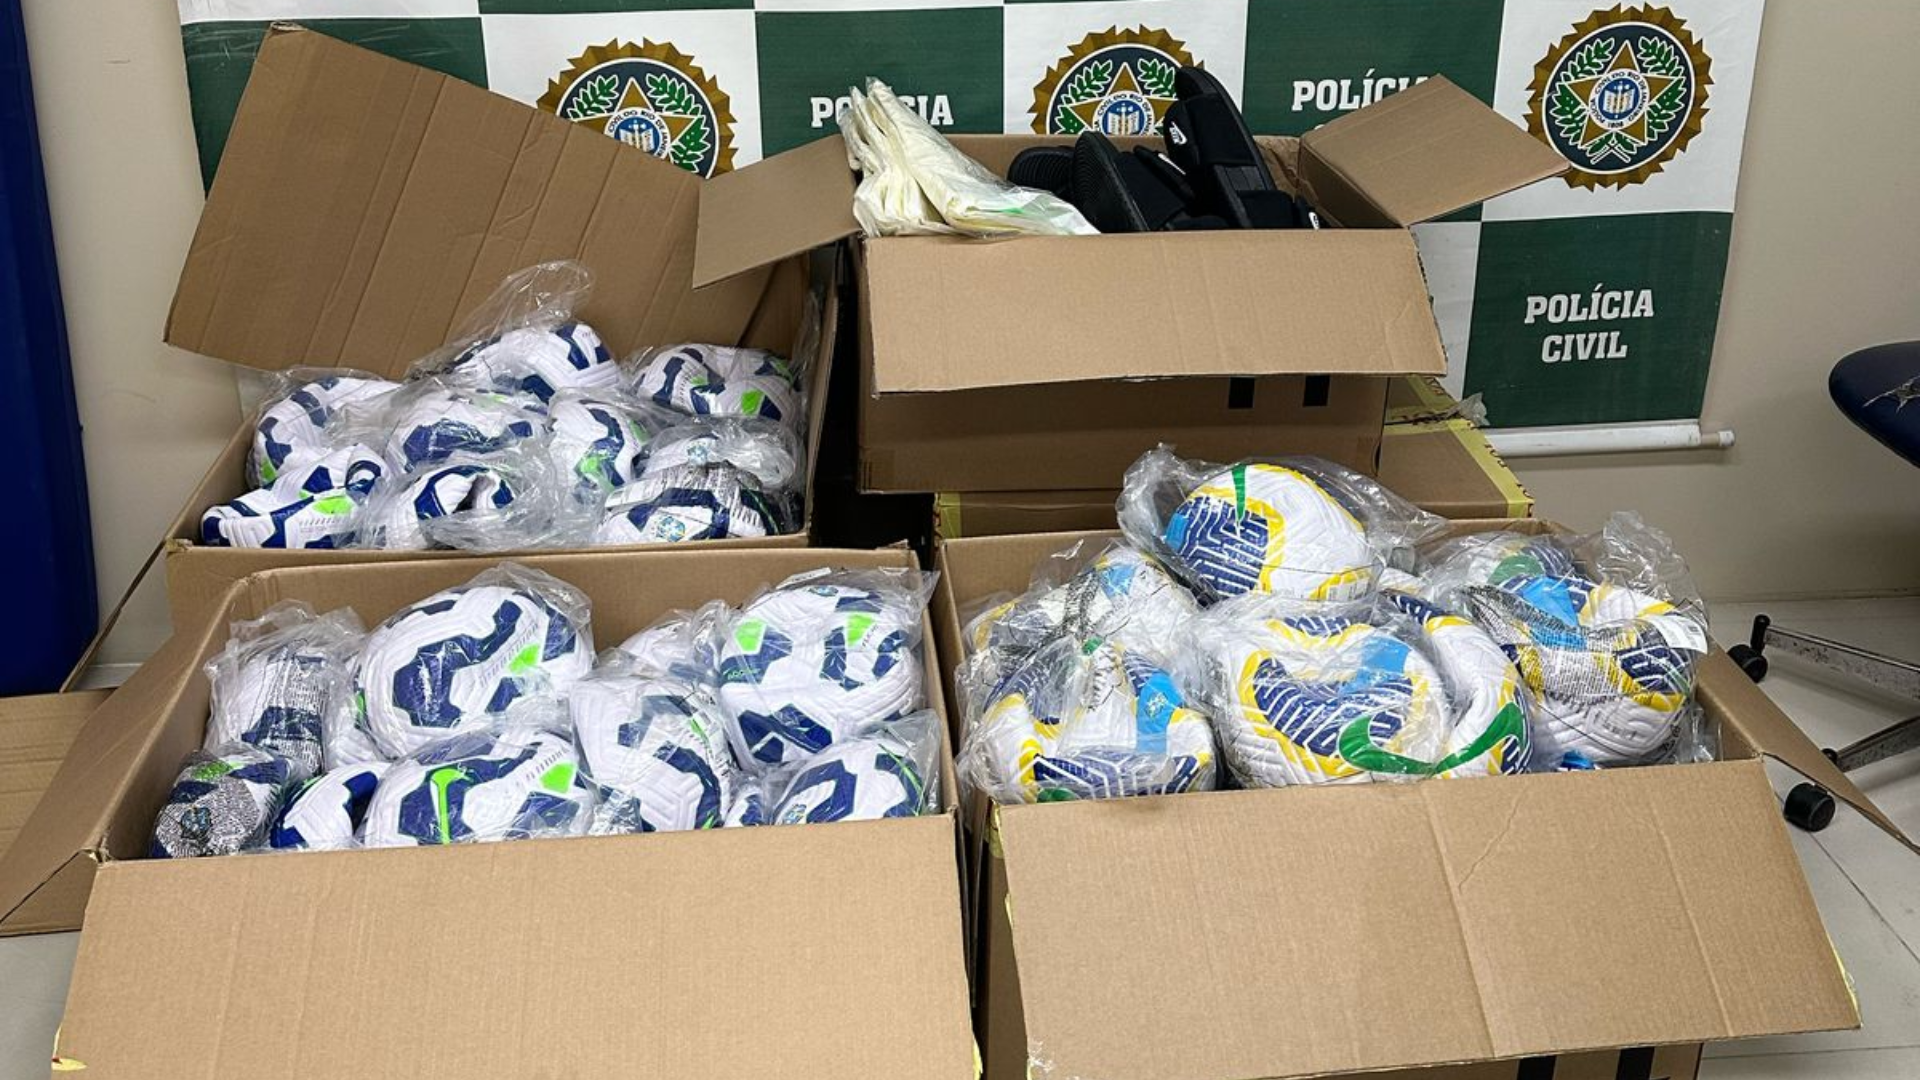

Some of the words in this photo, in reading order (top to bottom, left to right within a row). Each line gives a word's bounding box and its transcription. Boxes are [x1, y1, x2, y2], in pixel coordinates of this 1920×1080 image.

[1291, 68, 1429, 111] POLÍC
[1595, 76, 1611, 94] CIVIL
[1611, 71, 1625, 79] DO
[608, 114, 623, 132] CIVIL
[641, 110, 655, 120] RIO
[1524, 282, 1654, 324] POLÍCIA
[1541, 330, 1628, 363] CIVIL
